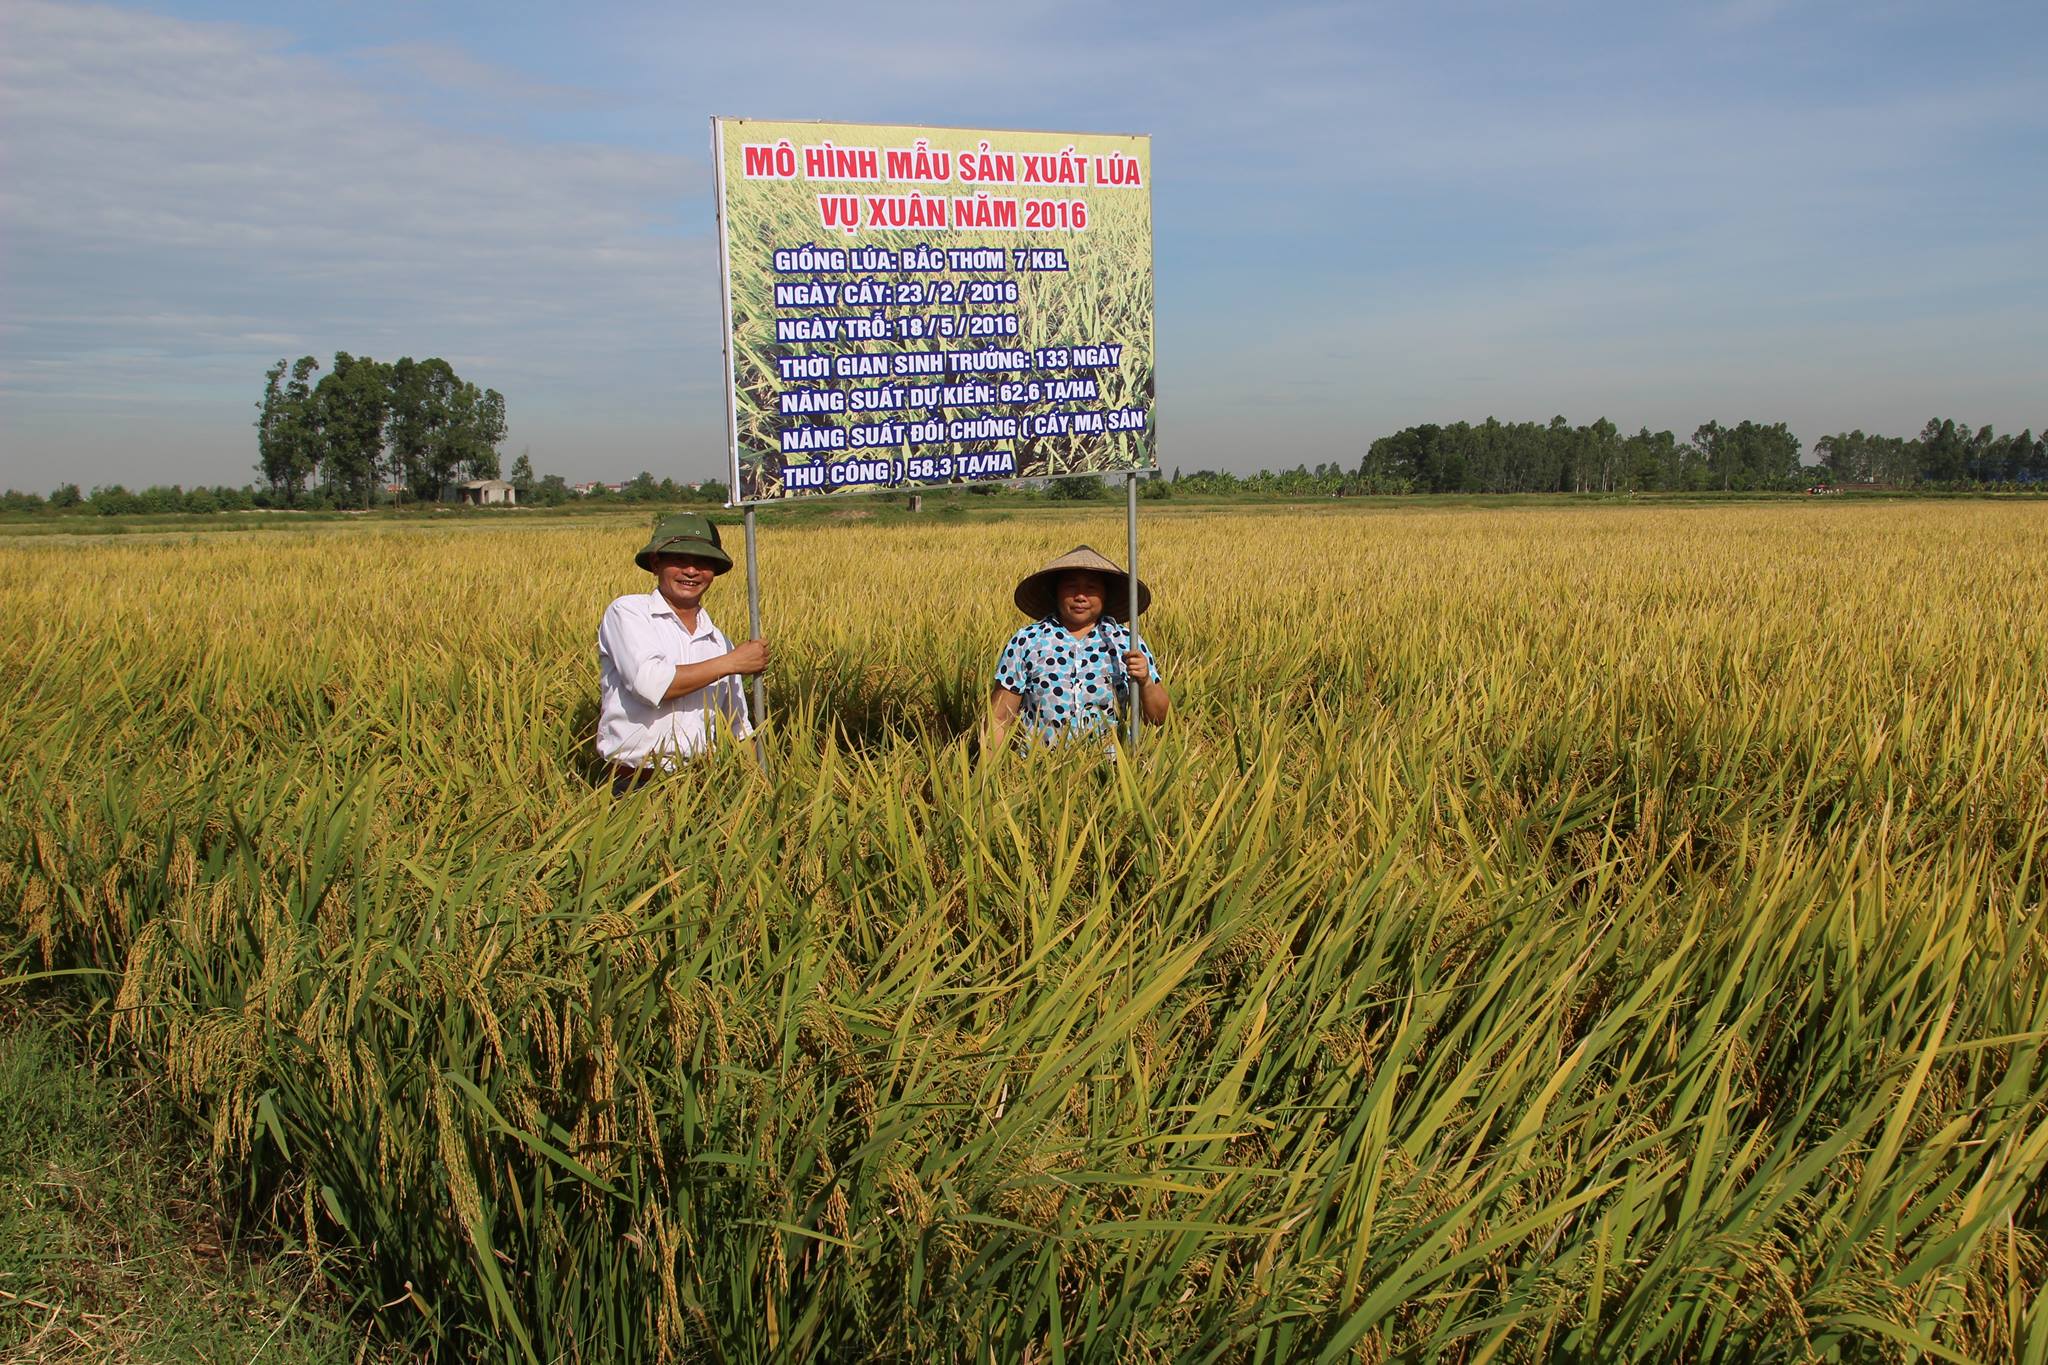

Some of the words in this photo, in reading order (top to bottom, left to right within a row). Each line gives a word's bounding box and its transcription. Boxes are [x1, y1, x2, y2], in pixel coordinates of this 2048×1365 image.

[745, 142, 796, 177] MÔ
[805, 143, 878, 178] HÌNH
[886, 141, 950, 180] MẪU
[959, 142, 1015, 181] SẢN
[1023, 147, 1087, 183] XUẤT
[1095, 153, 1141, 185] LÚA
[820, 197, 859, 232] VỤ
[869, 193, 946, 227] XUÂN
[955, 194, 1017, 227] NĂM
[1025, 201, 1086, 228] 2016
[775, 245, 845, 271] GIỐNG
[851, 247, 897, 270] LÚA:
[903, 245, 944, 270] BẮC
[949, 250, 1004, 269] THƠM
[1014, 251, 1027, 269] 7
[1032, 251, 1067, 269] KBL
[777, 281, 838, 305] NGÀY
[844, 278, 892, 303] CẤY:
[778, 316, 839, 340] NGÀY
[845, 312, 892, 338] TRỖ:
[779, 354, 830, 378] THỜI
[836, 355, 888, 376] GIAN
[894, 353, 943, 374] SINH
[949, 344, 1030, 371] TRƯỞNG:
[1036, 349, 1068, 369] 133
[1073, 344, 1120, 366] NGÀY
[781, 389, 844, 413] NĂNG
[850, 383, 905, 410] SUẤT
[910, 385, 940, 410] DỰ
[943, 379, 995, 405] KIẾN:
[1000, 383, 1040, 403] 62,6
[1044, 380, 1097, 402] TẠ/HA
[783, 426, 845, 450] NĂNG
[851, 419, 905, 446] SUẤT
[909, 416, 944, 443] ĐỐI
[950, 415, 1016, 440] CHỨNG
[1074, 413, 1104, 435] MẠ
[1108, 408, 1144, 430] SÂN
[783, 459, 824, 487] THỦ
[909, 457, 952, 478] 58,3
[957, 453, 1013, 477] TẠ/HA
